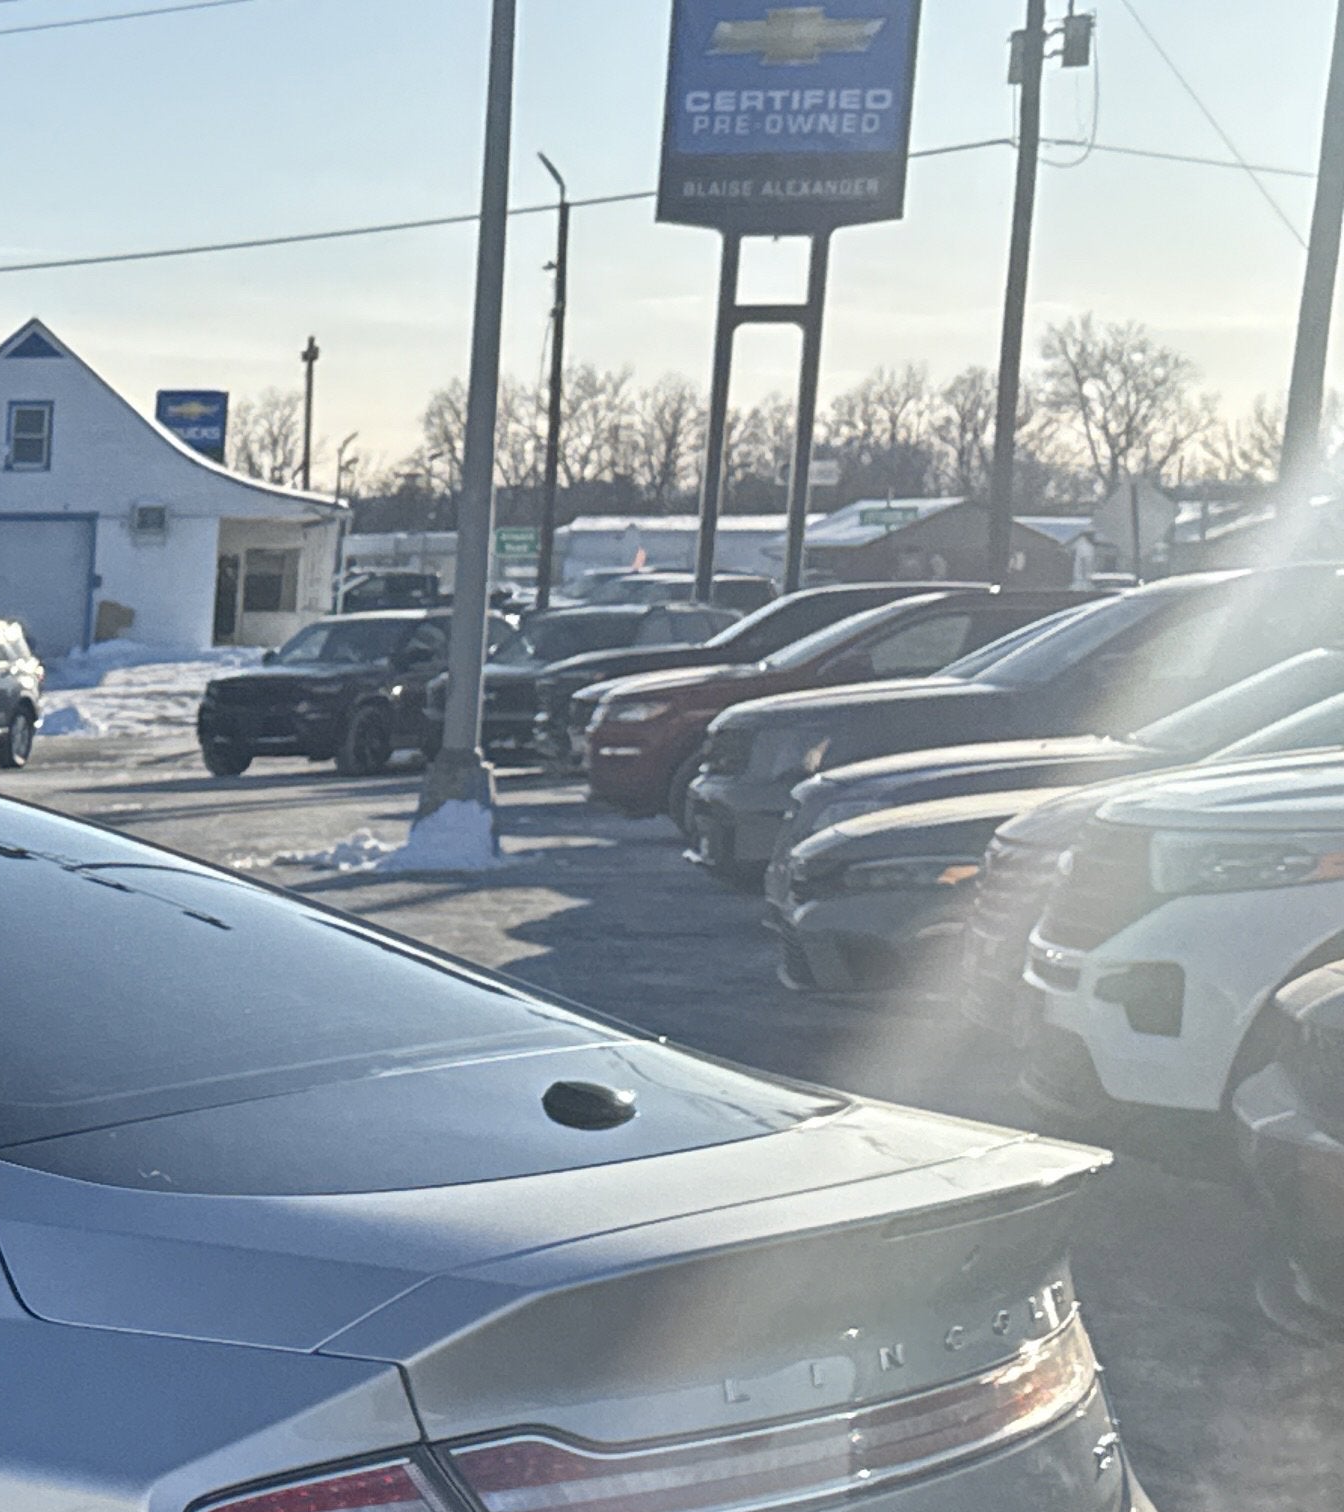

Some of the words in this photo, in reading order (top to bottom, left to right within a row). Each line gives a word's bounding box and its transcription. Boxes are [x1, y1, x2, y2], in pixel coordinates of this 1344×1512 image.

[684, 89, 893, 113] CERTIFIED
[692, 112, 881, 135] PRE-OWNED
[682, 181, 753, 197] BLAISE
[761, 178, 880, 196] ALEXANDER
[724, 1280, 1064, 1404] LINCOLN
